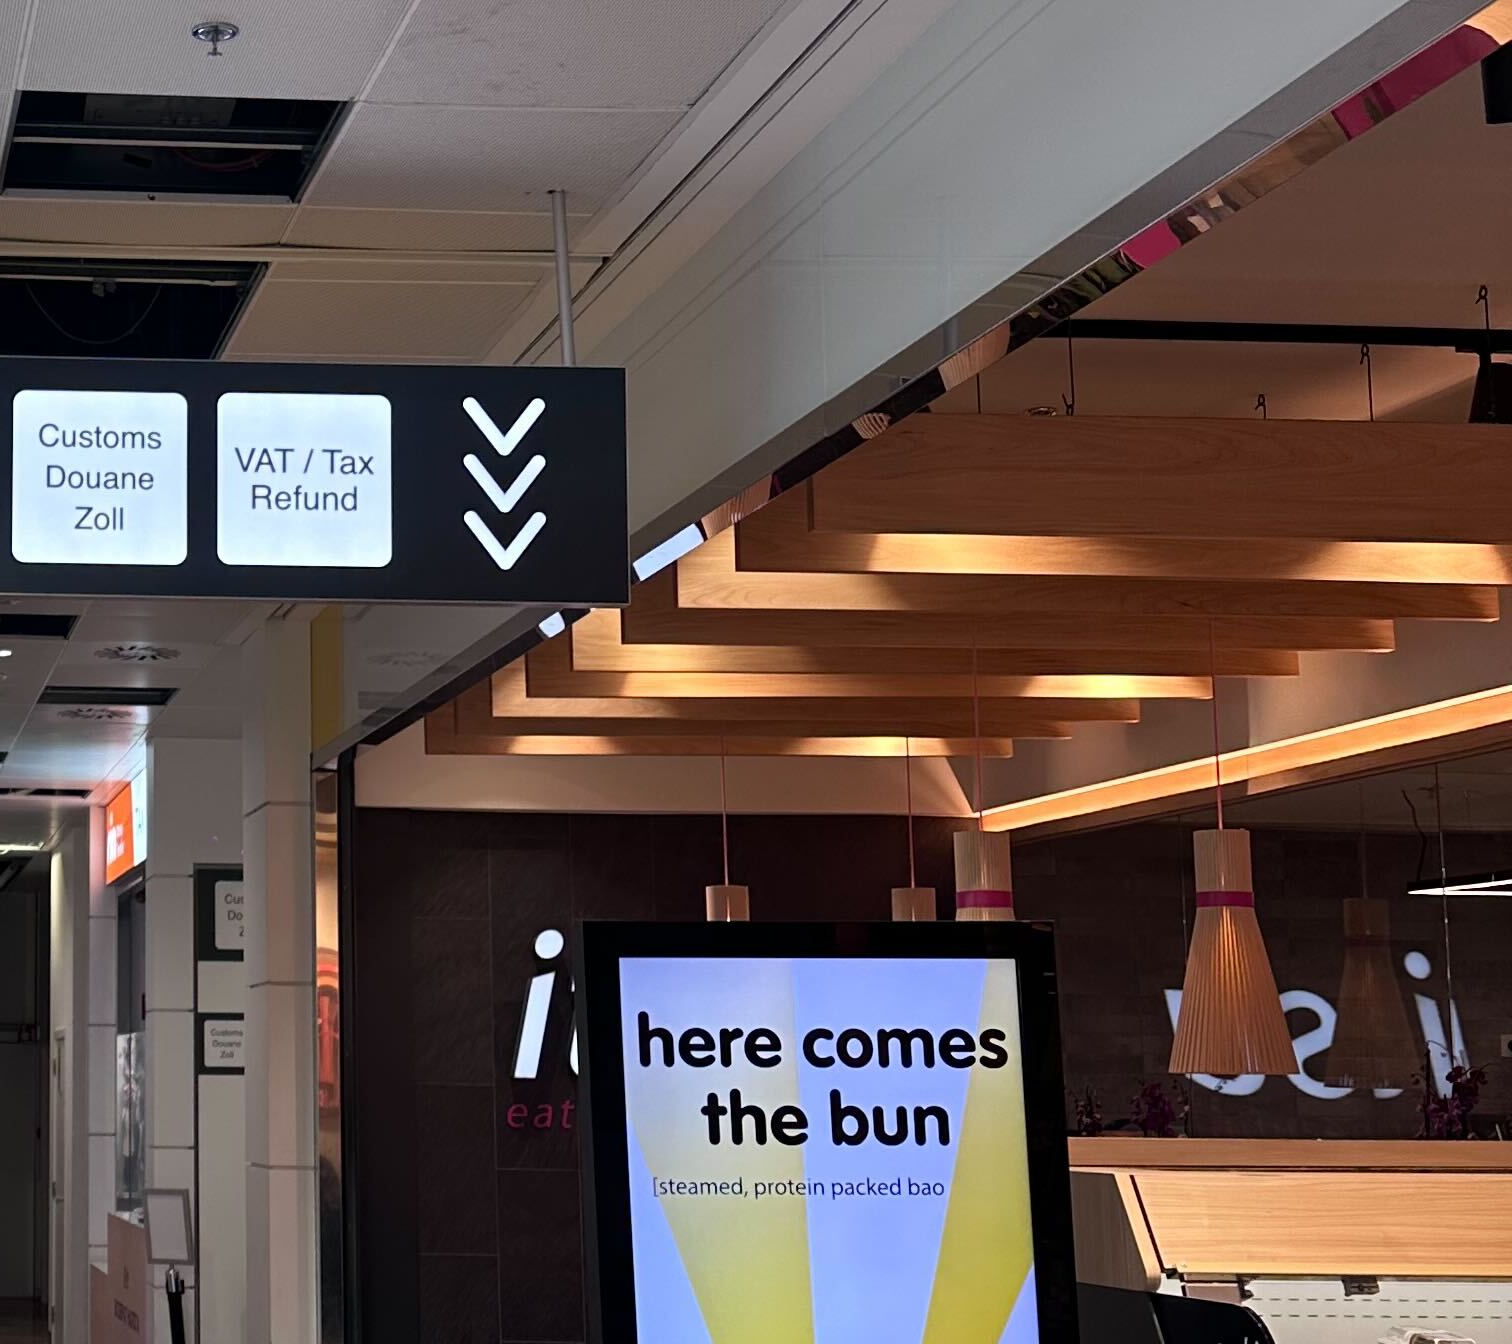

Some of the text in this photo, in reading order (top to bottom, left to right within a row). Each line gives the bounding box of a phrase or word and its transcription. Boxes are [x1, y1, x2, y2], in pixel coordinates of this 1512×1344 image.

[38, 423, 162, 451] Customs
[234, 447, 295, 474] VAT
[322, 448, 375, 476] Tax
[46, 464, 155, 492] Douane
[251, 484, 359, 512] Refund
[74, 506, 125, 532] Zoll
[637, 1011, 1009, 1069] here comes
[505, 1099, 576, 1128] eat
[700, 1088, 951, 1147] the bun
[754, 1178, 825, 1200] protein
[831, 1177, 902, 1200] packed
[908, 1177, 945, 1196] bao
